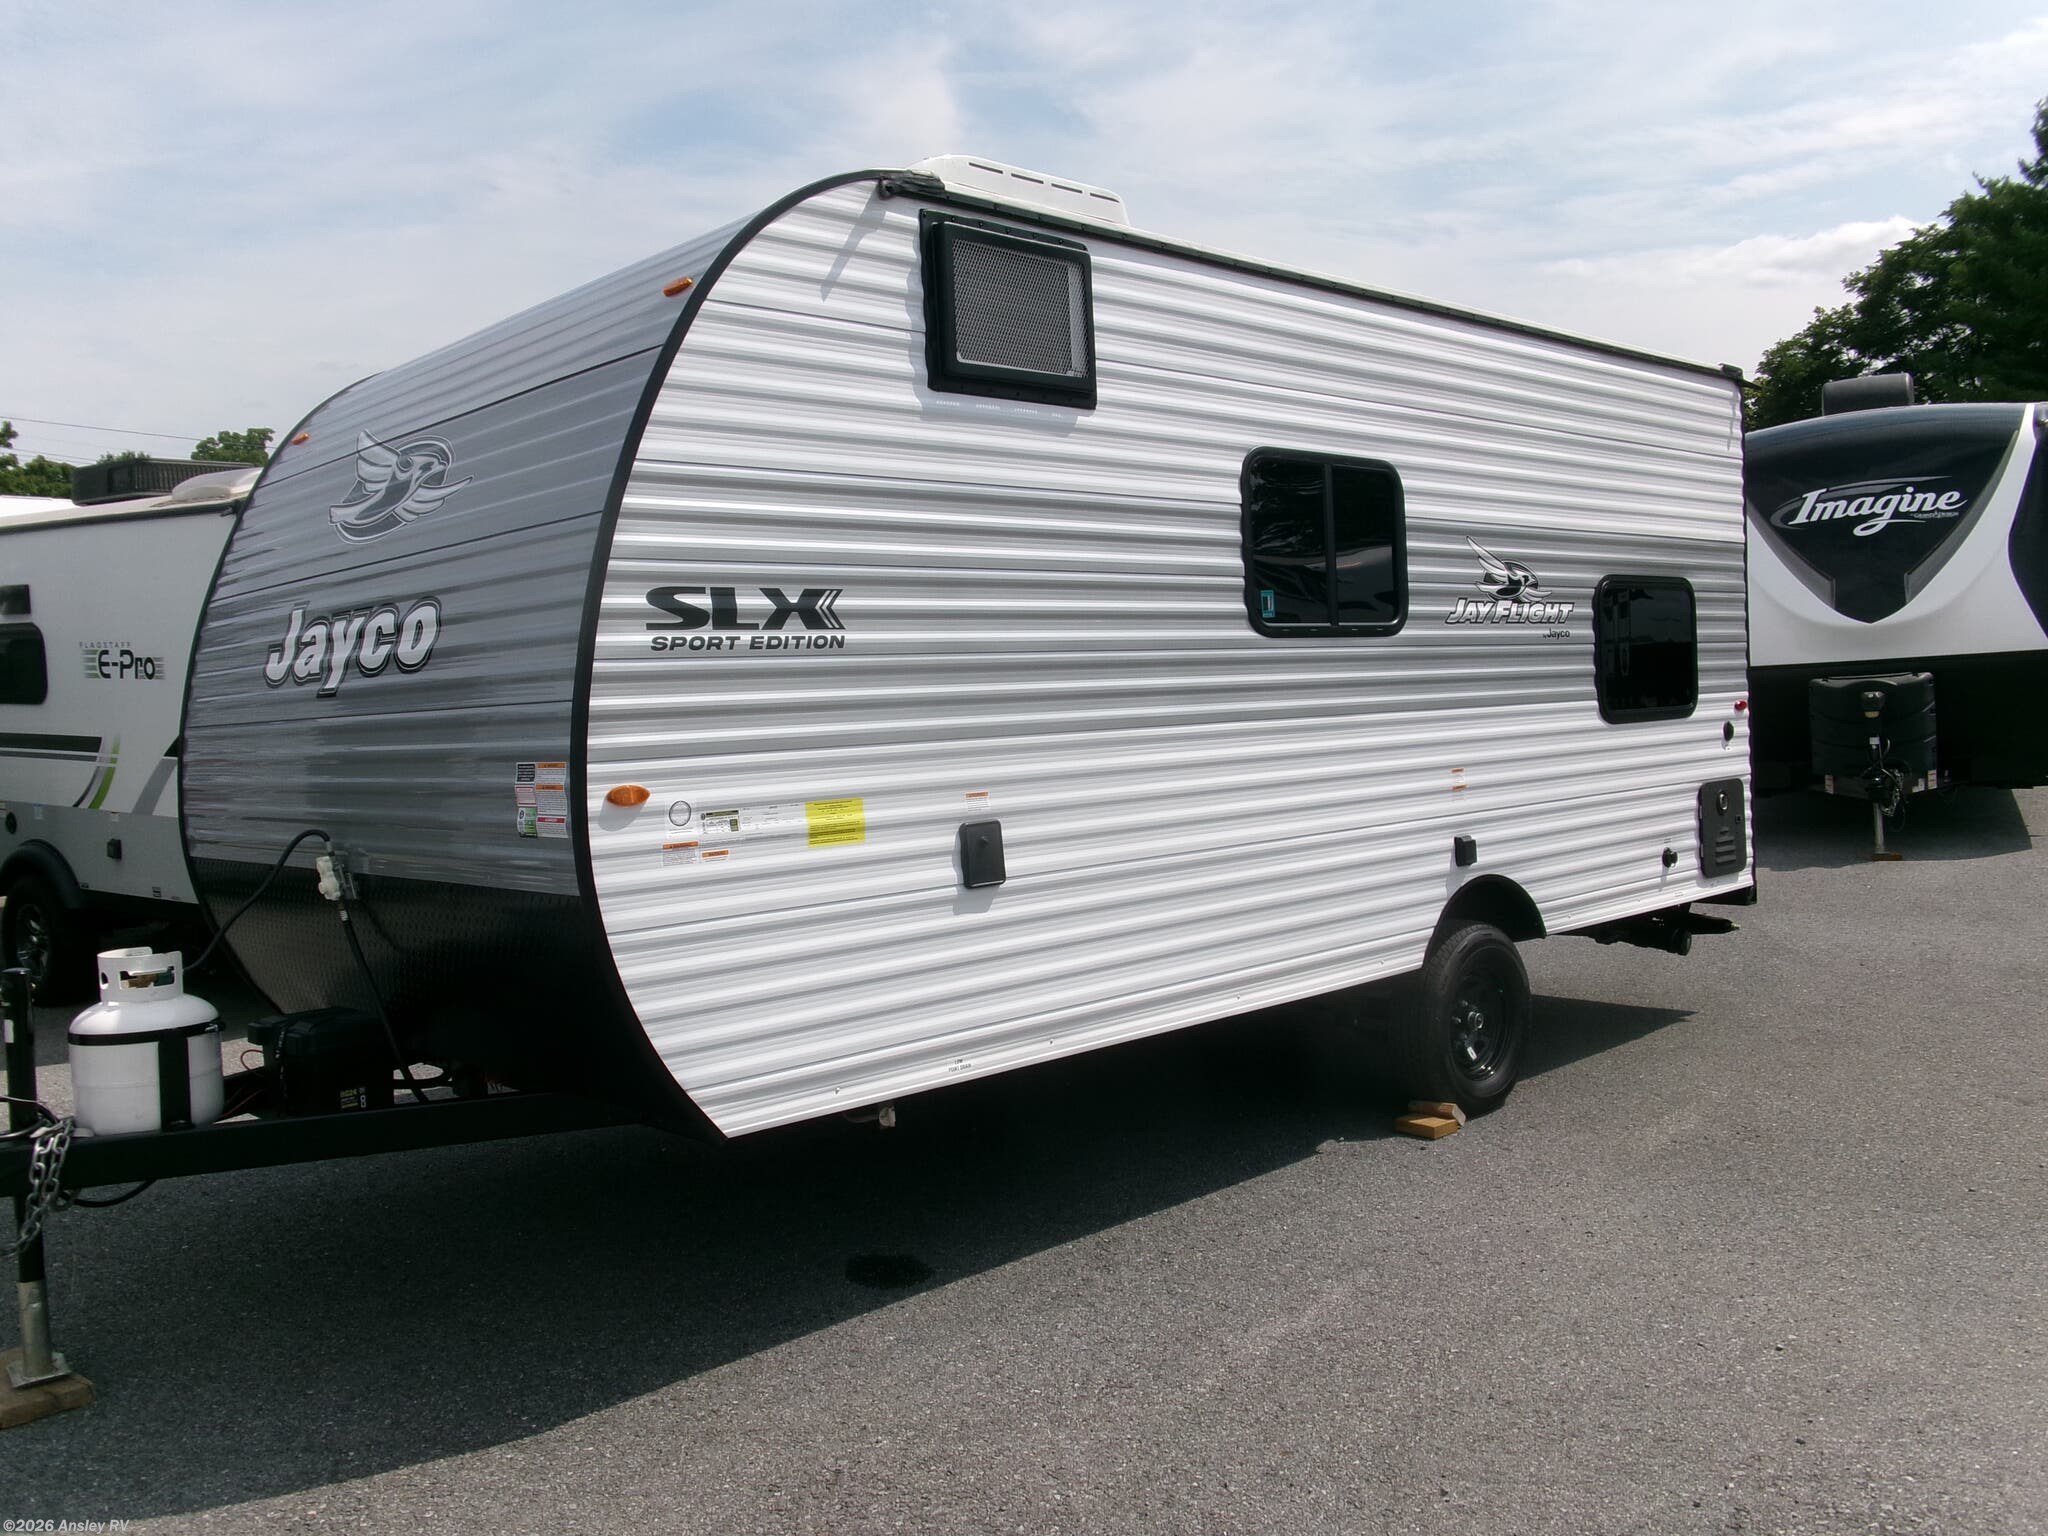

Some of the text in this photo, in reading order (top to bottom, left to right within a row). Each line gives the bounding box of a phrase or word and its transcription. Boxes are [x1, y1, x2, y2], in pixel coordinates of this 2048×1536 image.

[1788, 486, 1968, 537] Imagine
[645, 586, 846, 630] SLX
[1446, 598, 1575, 624] JAY FLIGHT
[264, 597, 441, 698] Jayco
[650, 635, 846, 651] SPORT EDITION
[1547, 627, 1571, 640] Jayco
[98, 649, 156, 680] E-Pro
